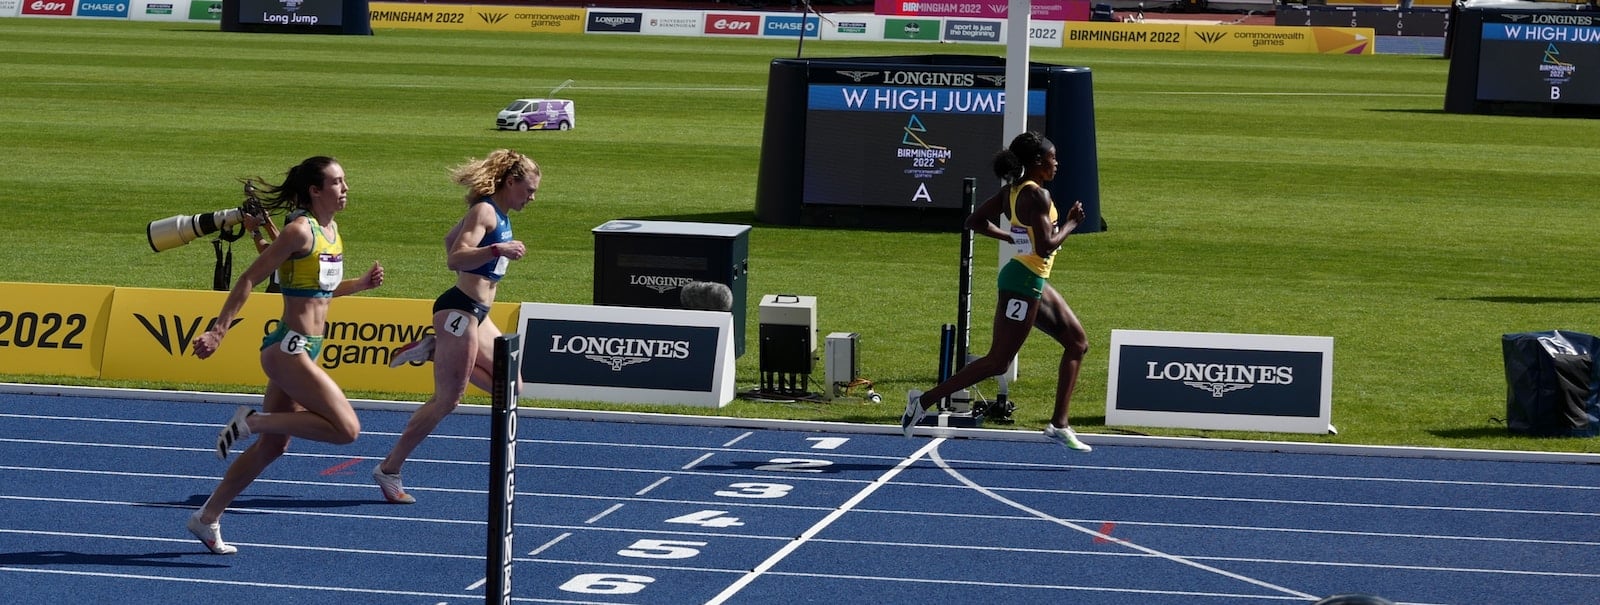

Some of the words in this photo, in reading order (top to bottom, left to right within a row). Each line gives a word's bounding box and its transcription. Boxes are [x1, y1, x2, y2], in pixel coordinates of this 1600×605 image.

[81, 3, 115, 11] CHASE
[902, 1, 956, 13] BIRMINGHAM
[959, 3, 981, 13] 2022
[263, 12, 288, 24] Long
[290, 13, 318, 25] Jump
[369, 11, 432, 22] IRMINGHAM
[435, 13, 464, 23] 2022
[514, 12, 580, 21] commonwealth
[1532, 14, 1592, 26] LONGINES
[530, 20, 561, 28] games
[768, 22, 804, 31] CHASE
[1029, 28, 1057, 39] 2022
[1070, 30, 1147, 42] BIRMINGHAM
[1149, 31, 1180, 42] 2022
[1234, 31, 1304, 40] commonwealth
[1505, 25, 1522, 39] W
[1525, 26, 1567, 41] HIGH
[883, 71, 975, 87] LONGINES
[842, 88, 868, 108] W
[874, 89, 936, 111] HIGH
[1551, 86, 1561, 100] B
[897, 149, 952, 160] BIRMINGHAM
[913, 158, 935, 168] 2022
[912, 182, 932, 202] A
[1011, 302, 1022, 318] 2
[451, 316, 463, 333] 4
[288, 335, 301, 352] 6
[550, 335, 690, 359] LONGINES
[1146, 361, 1293, 385] LONGINES
[806, 437, 850, 449] 1
[753, 458, 833, 472] 2
[714, 483, 794, 498] 3
[664, 510, 745, 527] 4
[617, 539, 708, 559] 5
[559, 573, 656, 594] 6
